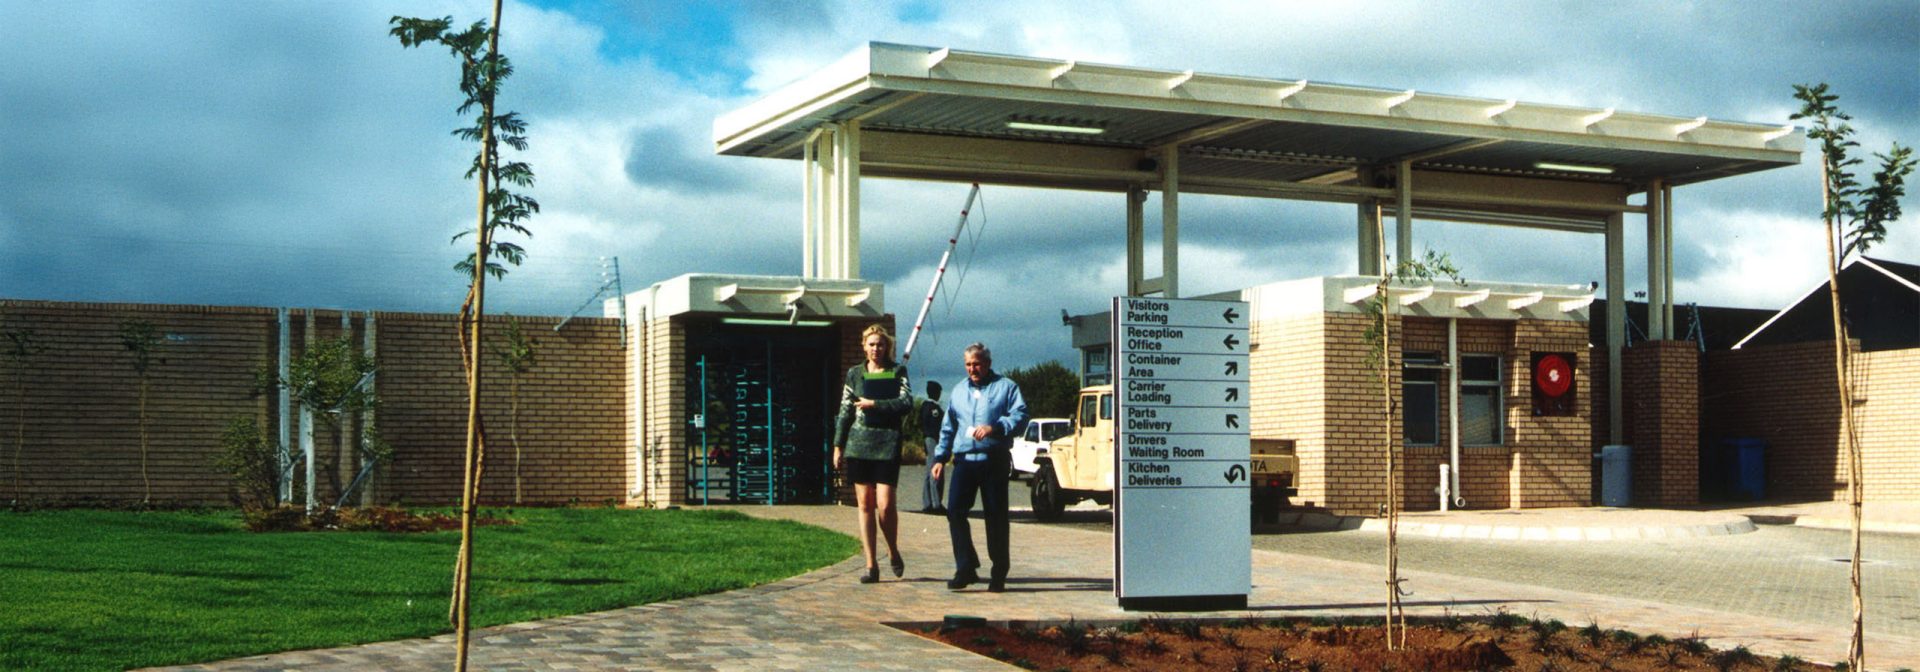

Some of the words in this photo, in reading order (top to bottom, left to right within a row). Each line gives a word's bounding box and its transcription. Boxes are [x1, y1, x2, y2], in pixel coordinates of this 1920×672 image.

[1127, 300, 1169, 311] Visitors
[1127, 312, 1168, 324] Parking
[1127, 327, 1183, 339] Reception
[1128, 339, 1162, 350] Office
[1128, 354, 1181, 365] Container
[1128, 366, 1154, 377] Area
[1128, 380, 1166, 391] Carrier
[1128, 391, 1171, 404] Loading
[1128, 407, 1156, 418] Parts
[1128, 419, 1172, 432] Delivery
[1128, 435, 1166, 445] Drivers
[1129, 447, 1169, 459] Waiting
[1172, 447, 1205, 457] Room
[1128, 463, 1170, 473] Kitchen
[1250, 459, 1267, 472] TA
[1128, 475, 1182, 486] Deliveries
